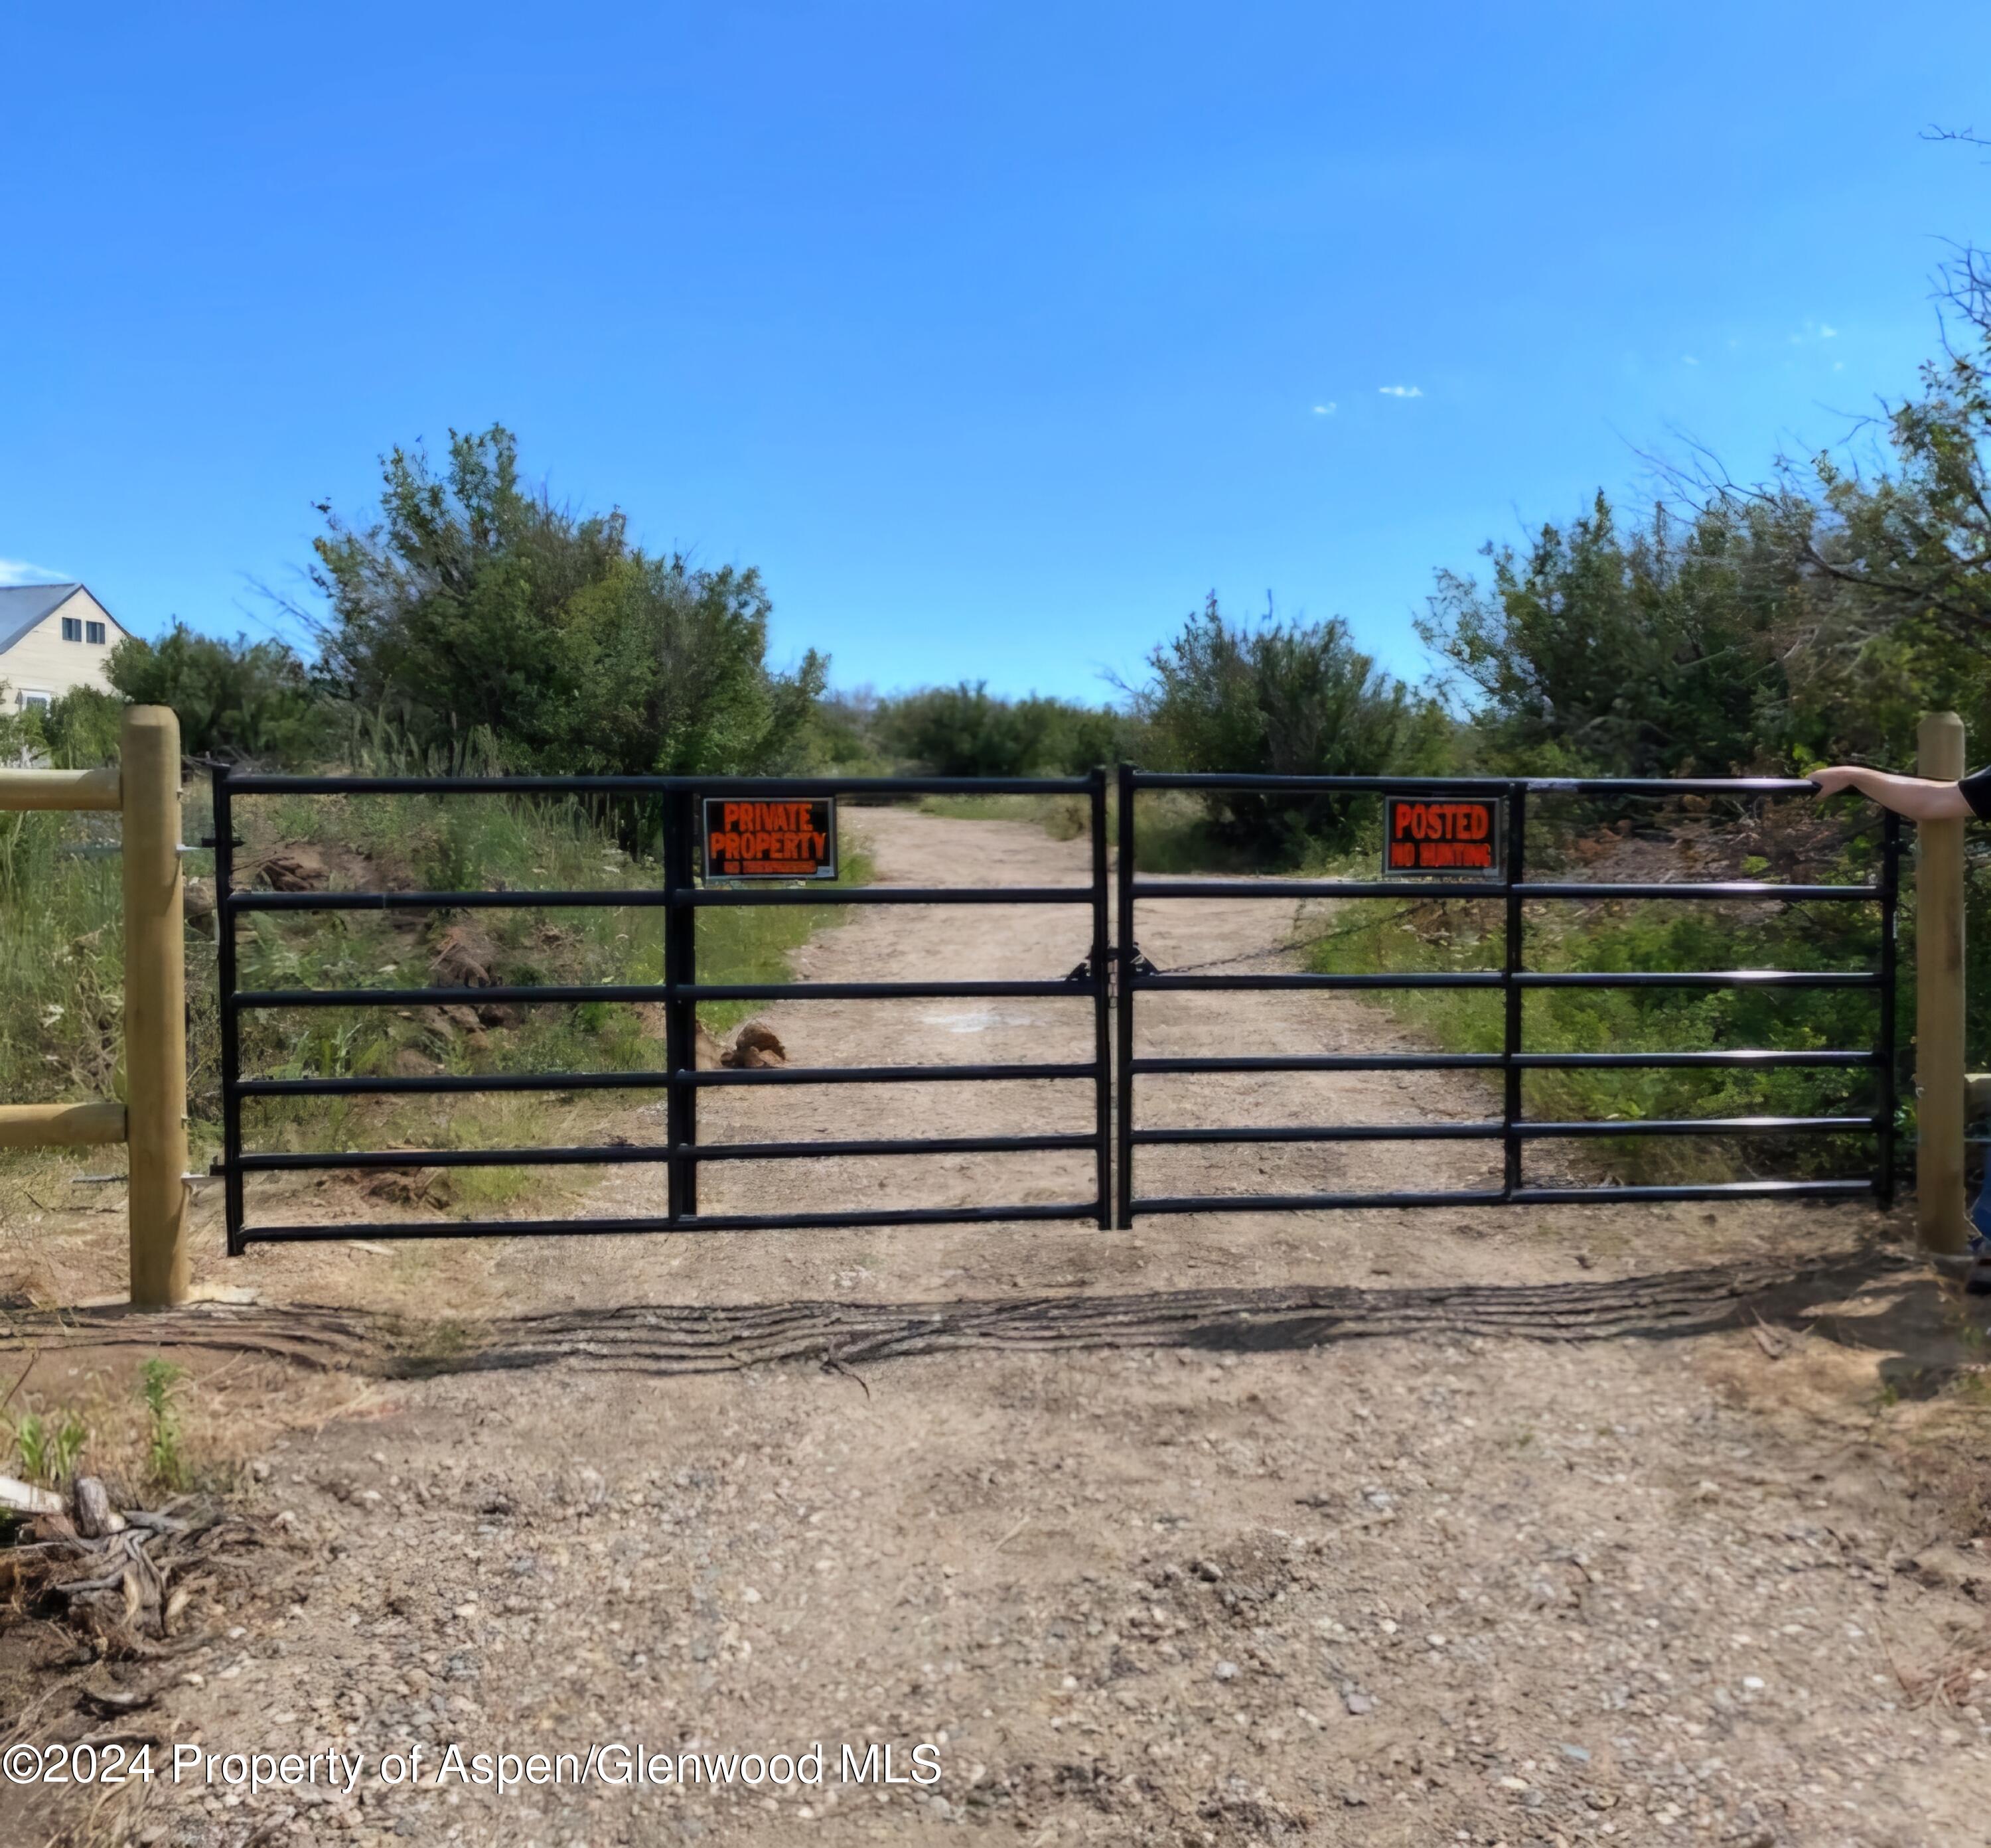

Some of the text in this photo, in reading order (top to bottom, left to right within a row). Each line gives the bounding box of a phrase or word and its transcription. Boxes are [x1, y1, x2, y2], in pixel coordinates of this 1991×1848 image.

[724, 802, 812, 831] PRIVATE
[1396, 804, 1489, 839] POSTED
[711, 831, 826, 859] PROPERTY
